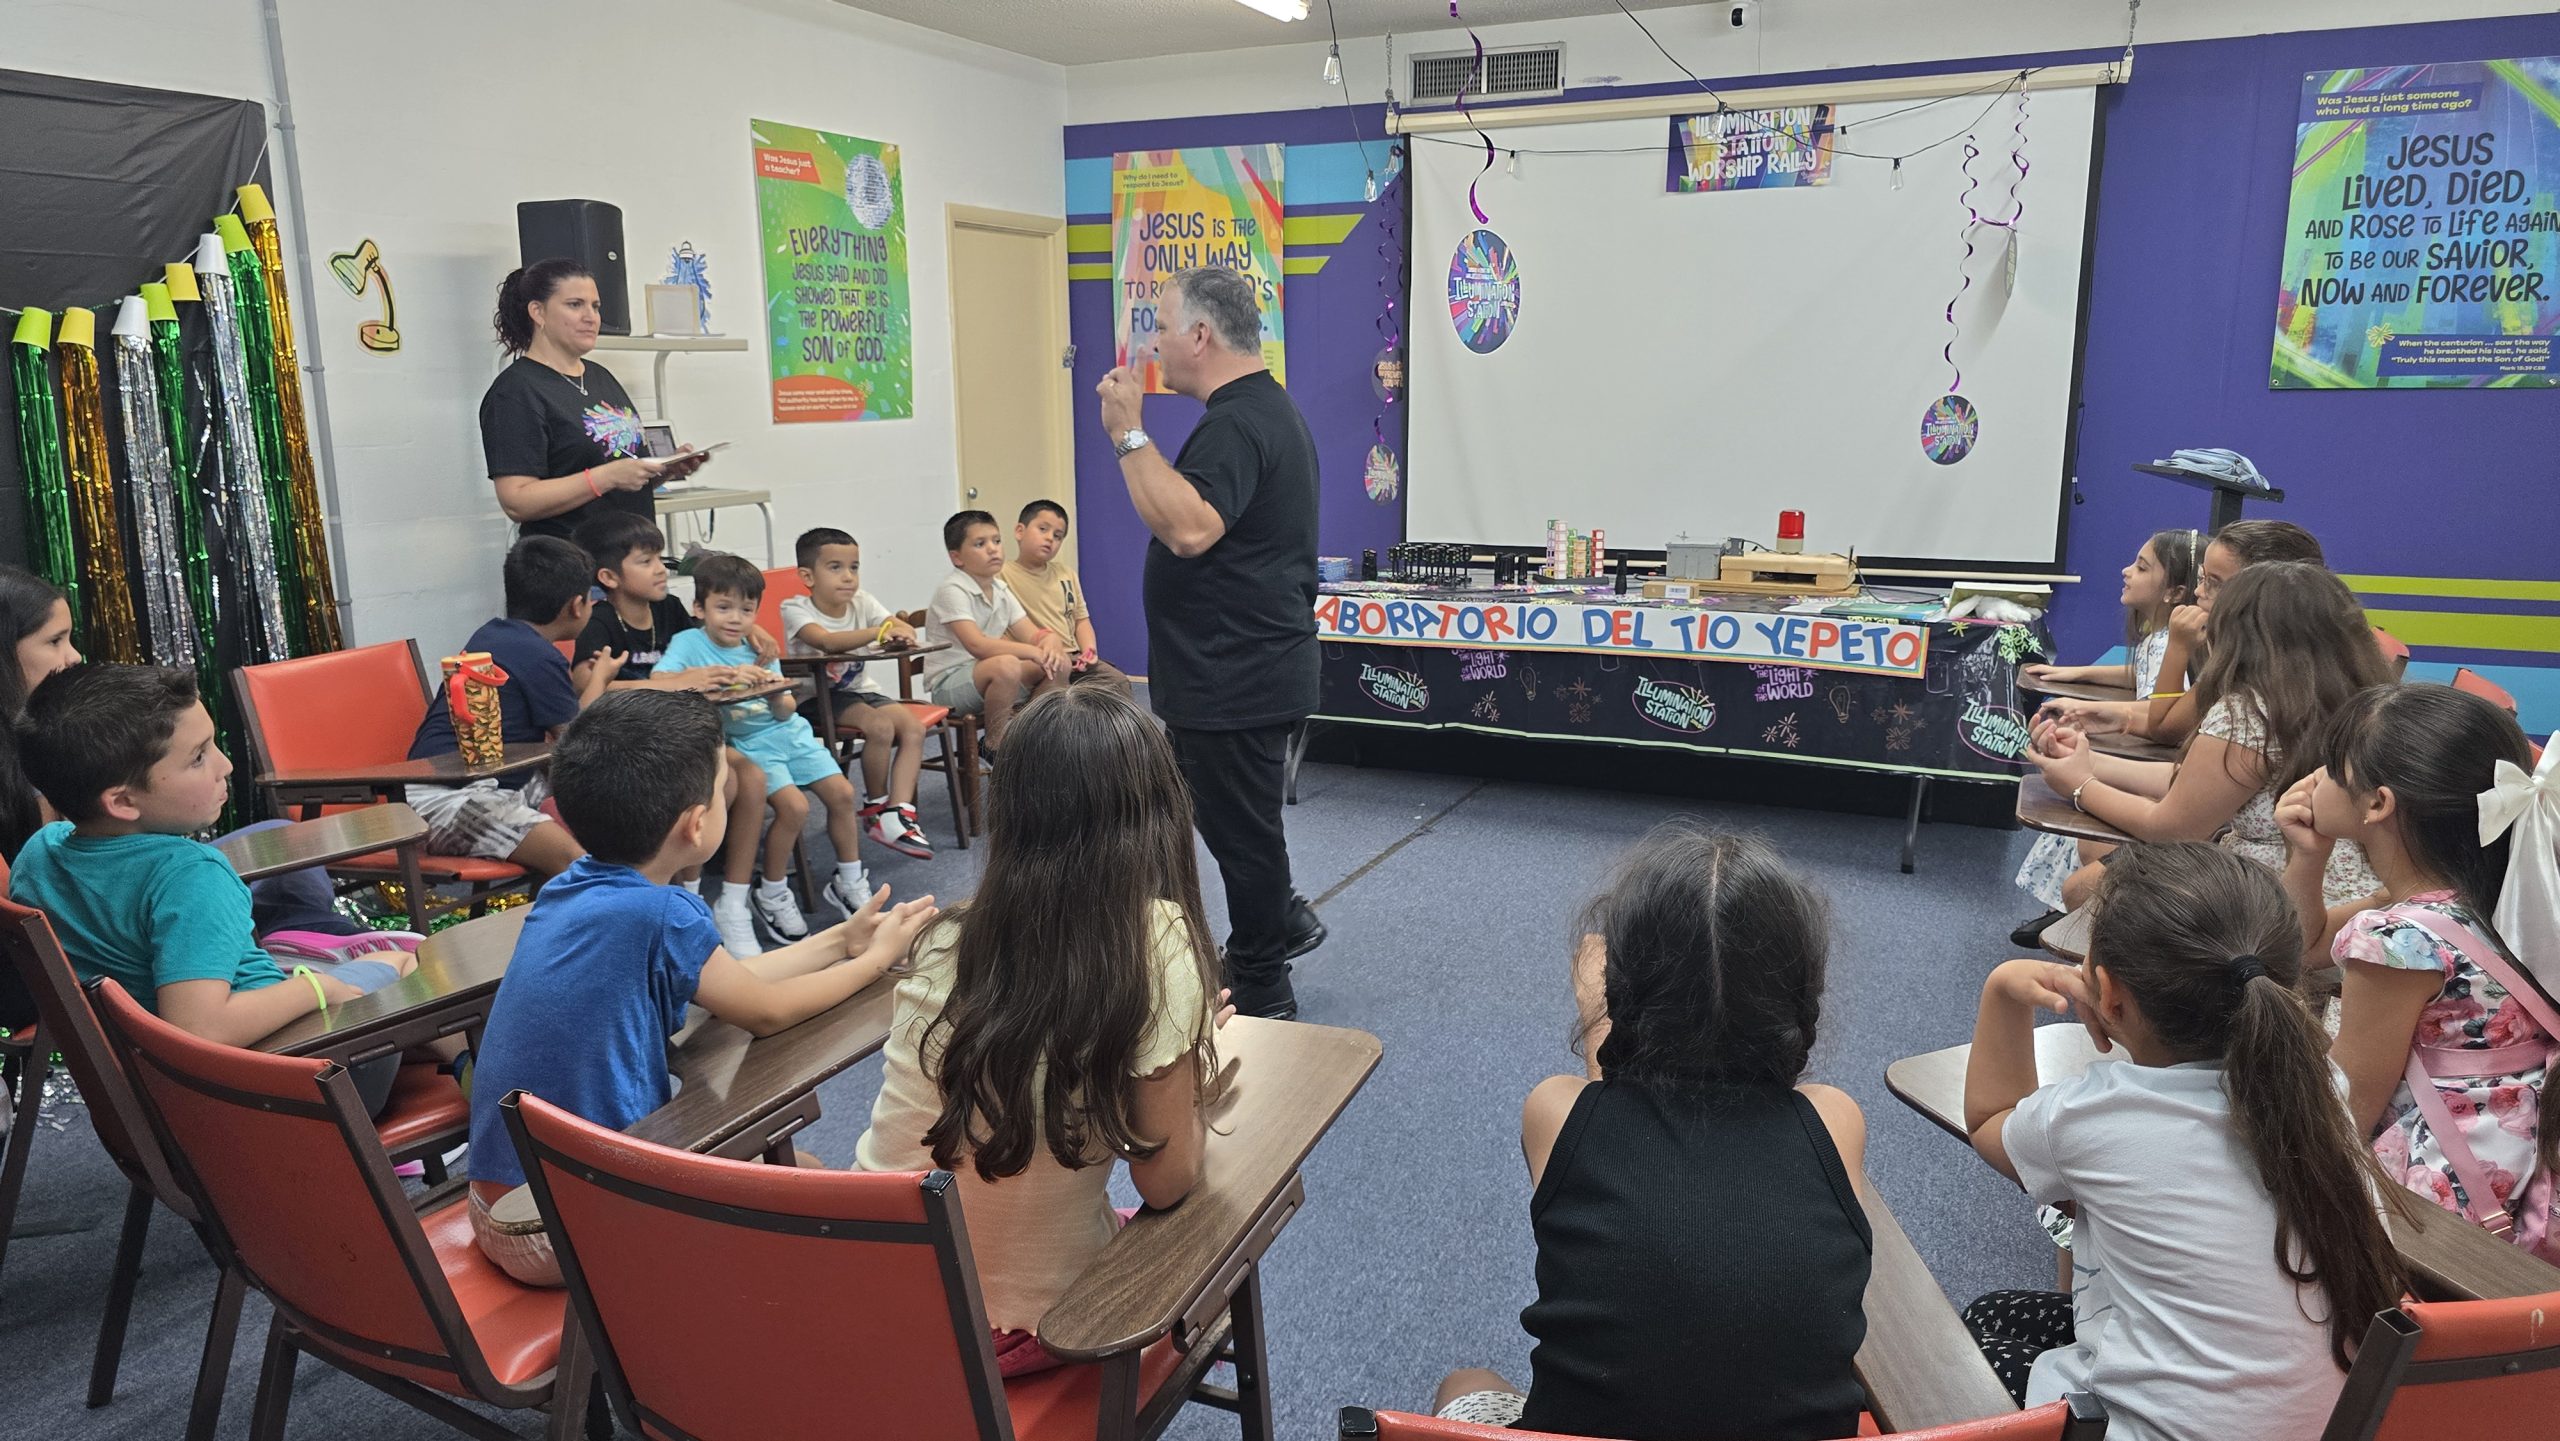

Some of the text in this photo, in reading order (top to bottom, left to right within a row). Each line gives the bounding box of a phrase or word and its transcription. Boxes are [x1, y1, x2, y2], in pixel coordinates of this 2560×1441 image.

[2315, 99, 2473, 116] who lived a long time ago?
[2317, 90, 2460, 105] Was Jesus just someone
[1695, 106, 1811, 138] ILLUMINATION
[1717, 131, 1788, 157] STATION
[2387, 132, 2495, 170] JESUS
[1688, 148, 1817, 182] WORSHIP RALLY
[1123, 181, 1151, 189] respond
[2342, 169, 2531, 211] LIVED, DIED,
[1139, 211, 1256, 241] JESUS IS THE
[2305, 219, 2343, 239] AND
[2350, 213, 2415, 239] ROSE
[2422, 216, 2442, 235] TO
[2448, 209, 2499, 238] LIFE
[789, 225, 888, 263] EVERYTHING
[1144, 241, 1252, 273] ONLY WAY
[2324, 238, 2534, 271] TO BE OUR SAVIOR,
[793, 262, 888, 285] JESUS SAID AND DID
[795, 286, 889, 308] SHOWED THAT HE IS
[1125, 281, 1146, 299] TO
[1453, 276, 1515, 302] ILLUMINATION
[2301, 272, 2551, 307] NOW AND FOREVER.
[798, 308, 888, 334] THE POWERFUL
[1467, 300, 1500, 319] STATION
[802, 336, 887, 364] SON OF GOD.
[2493, 347, 2514, 355] last,
[2528, 347, 2550, 355] said,
[2531, 339, 2551, 348] way
[2494, 355, 2511, 363] Son
[1582, 608, 1653, 647] DEL
[1671, 613, 1740, 650] TIO
[1755, 616, 1921, 667] YEPETO
[1360, 663, 1427, 706] ILLUMINATION
[1470, 664, 1507, 680] WORLD
[1754, 669, 1769, 679] THE
[1769, 667, 1800, 686] LIGHT
[1372, 683, 1411, 709] STATION
[1634, 675, 1713, 726] ILLUMINATION
[1754, 682, 1814, 702] THE WORLD
[1645, 701, 1691, 729] STATION
[1970, 724, 2019, 759] STATION
